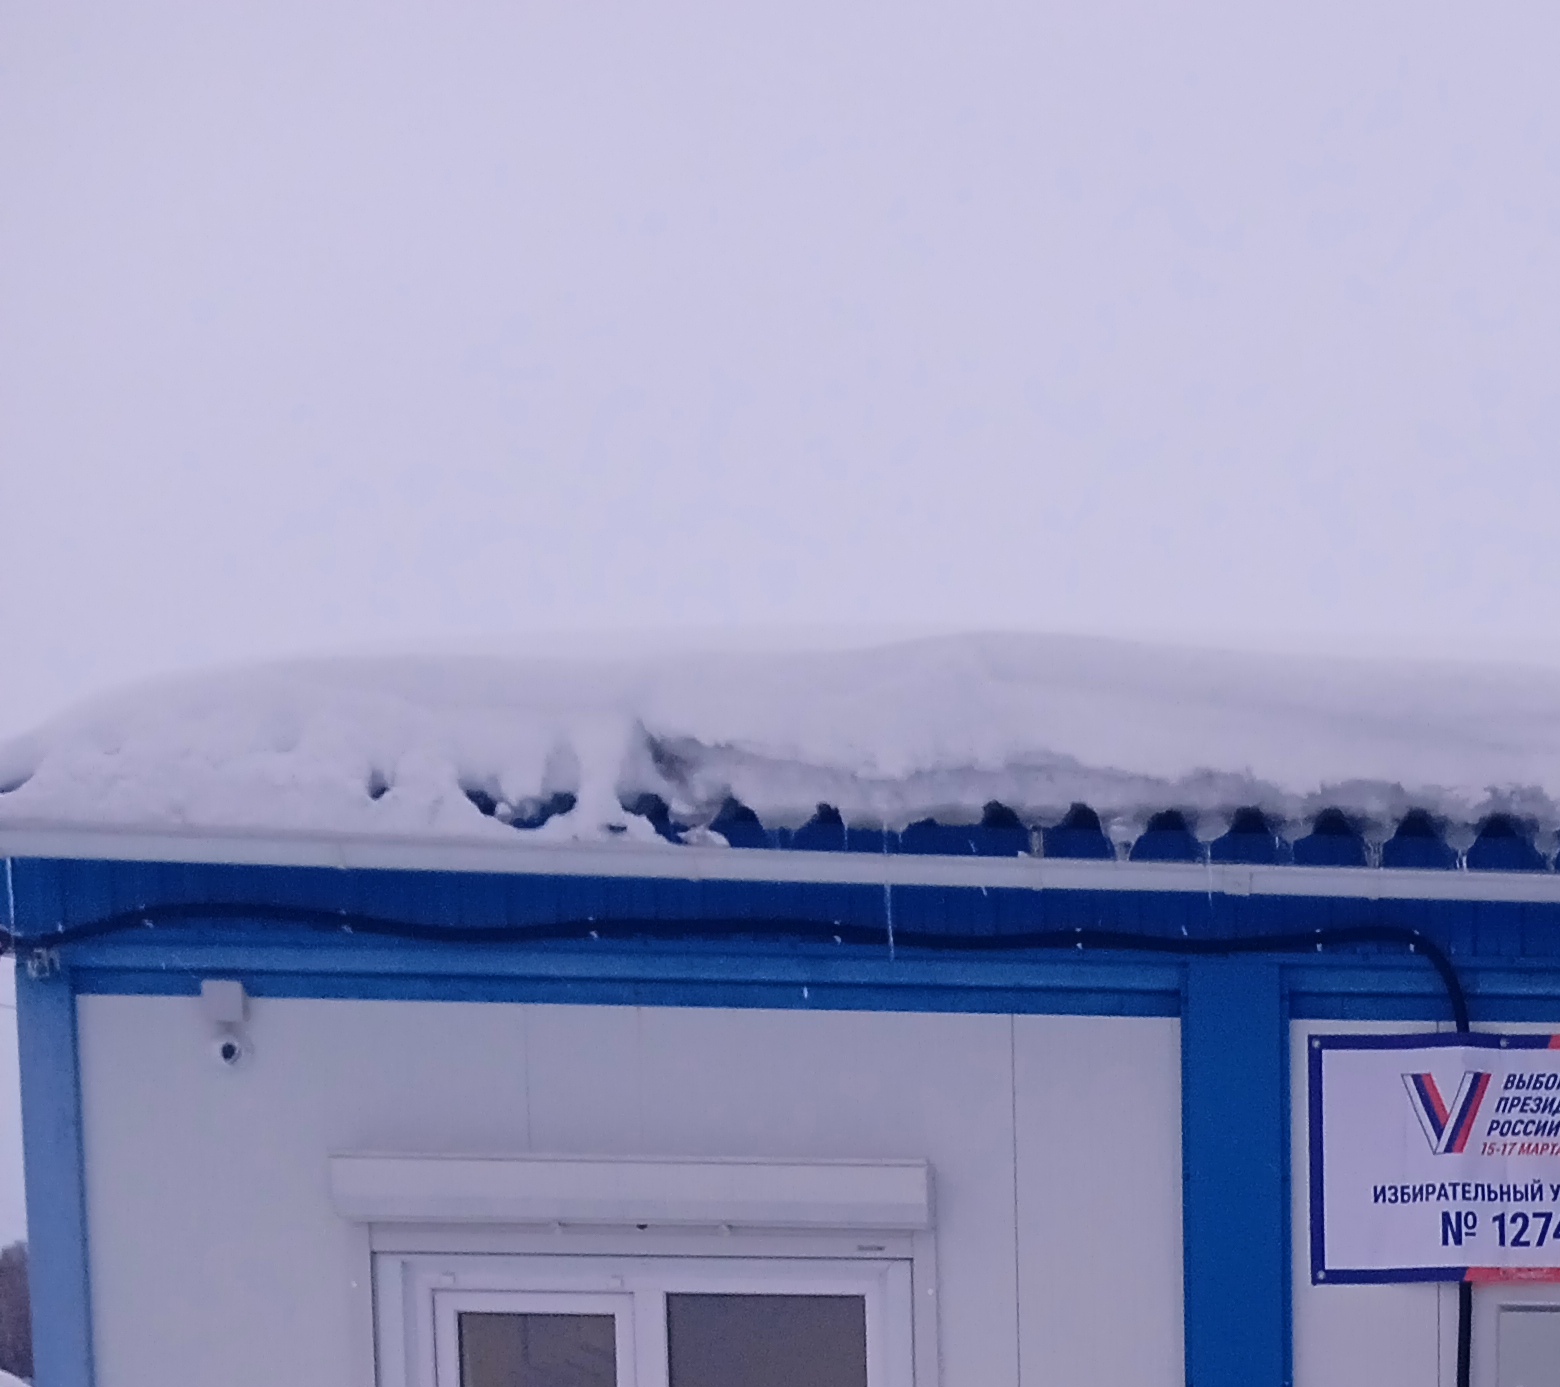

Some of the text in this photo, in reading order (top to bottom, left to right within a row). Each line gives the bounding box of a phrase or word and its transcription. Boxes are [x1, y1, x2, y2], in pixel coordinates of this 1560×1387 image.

[1480, 1142, 1518, 1157] 15-17
[1372, 1178, 1544, 1204] ИЗБИРАТЕЛЬНЫЙ
[1440, 1210, 1478, 1247] №
